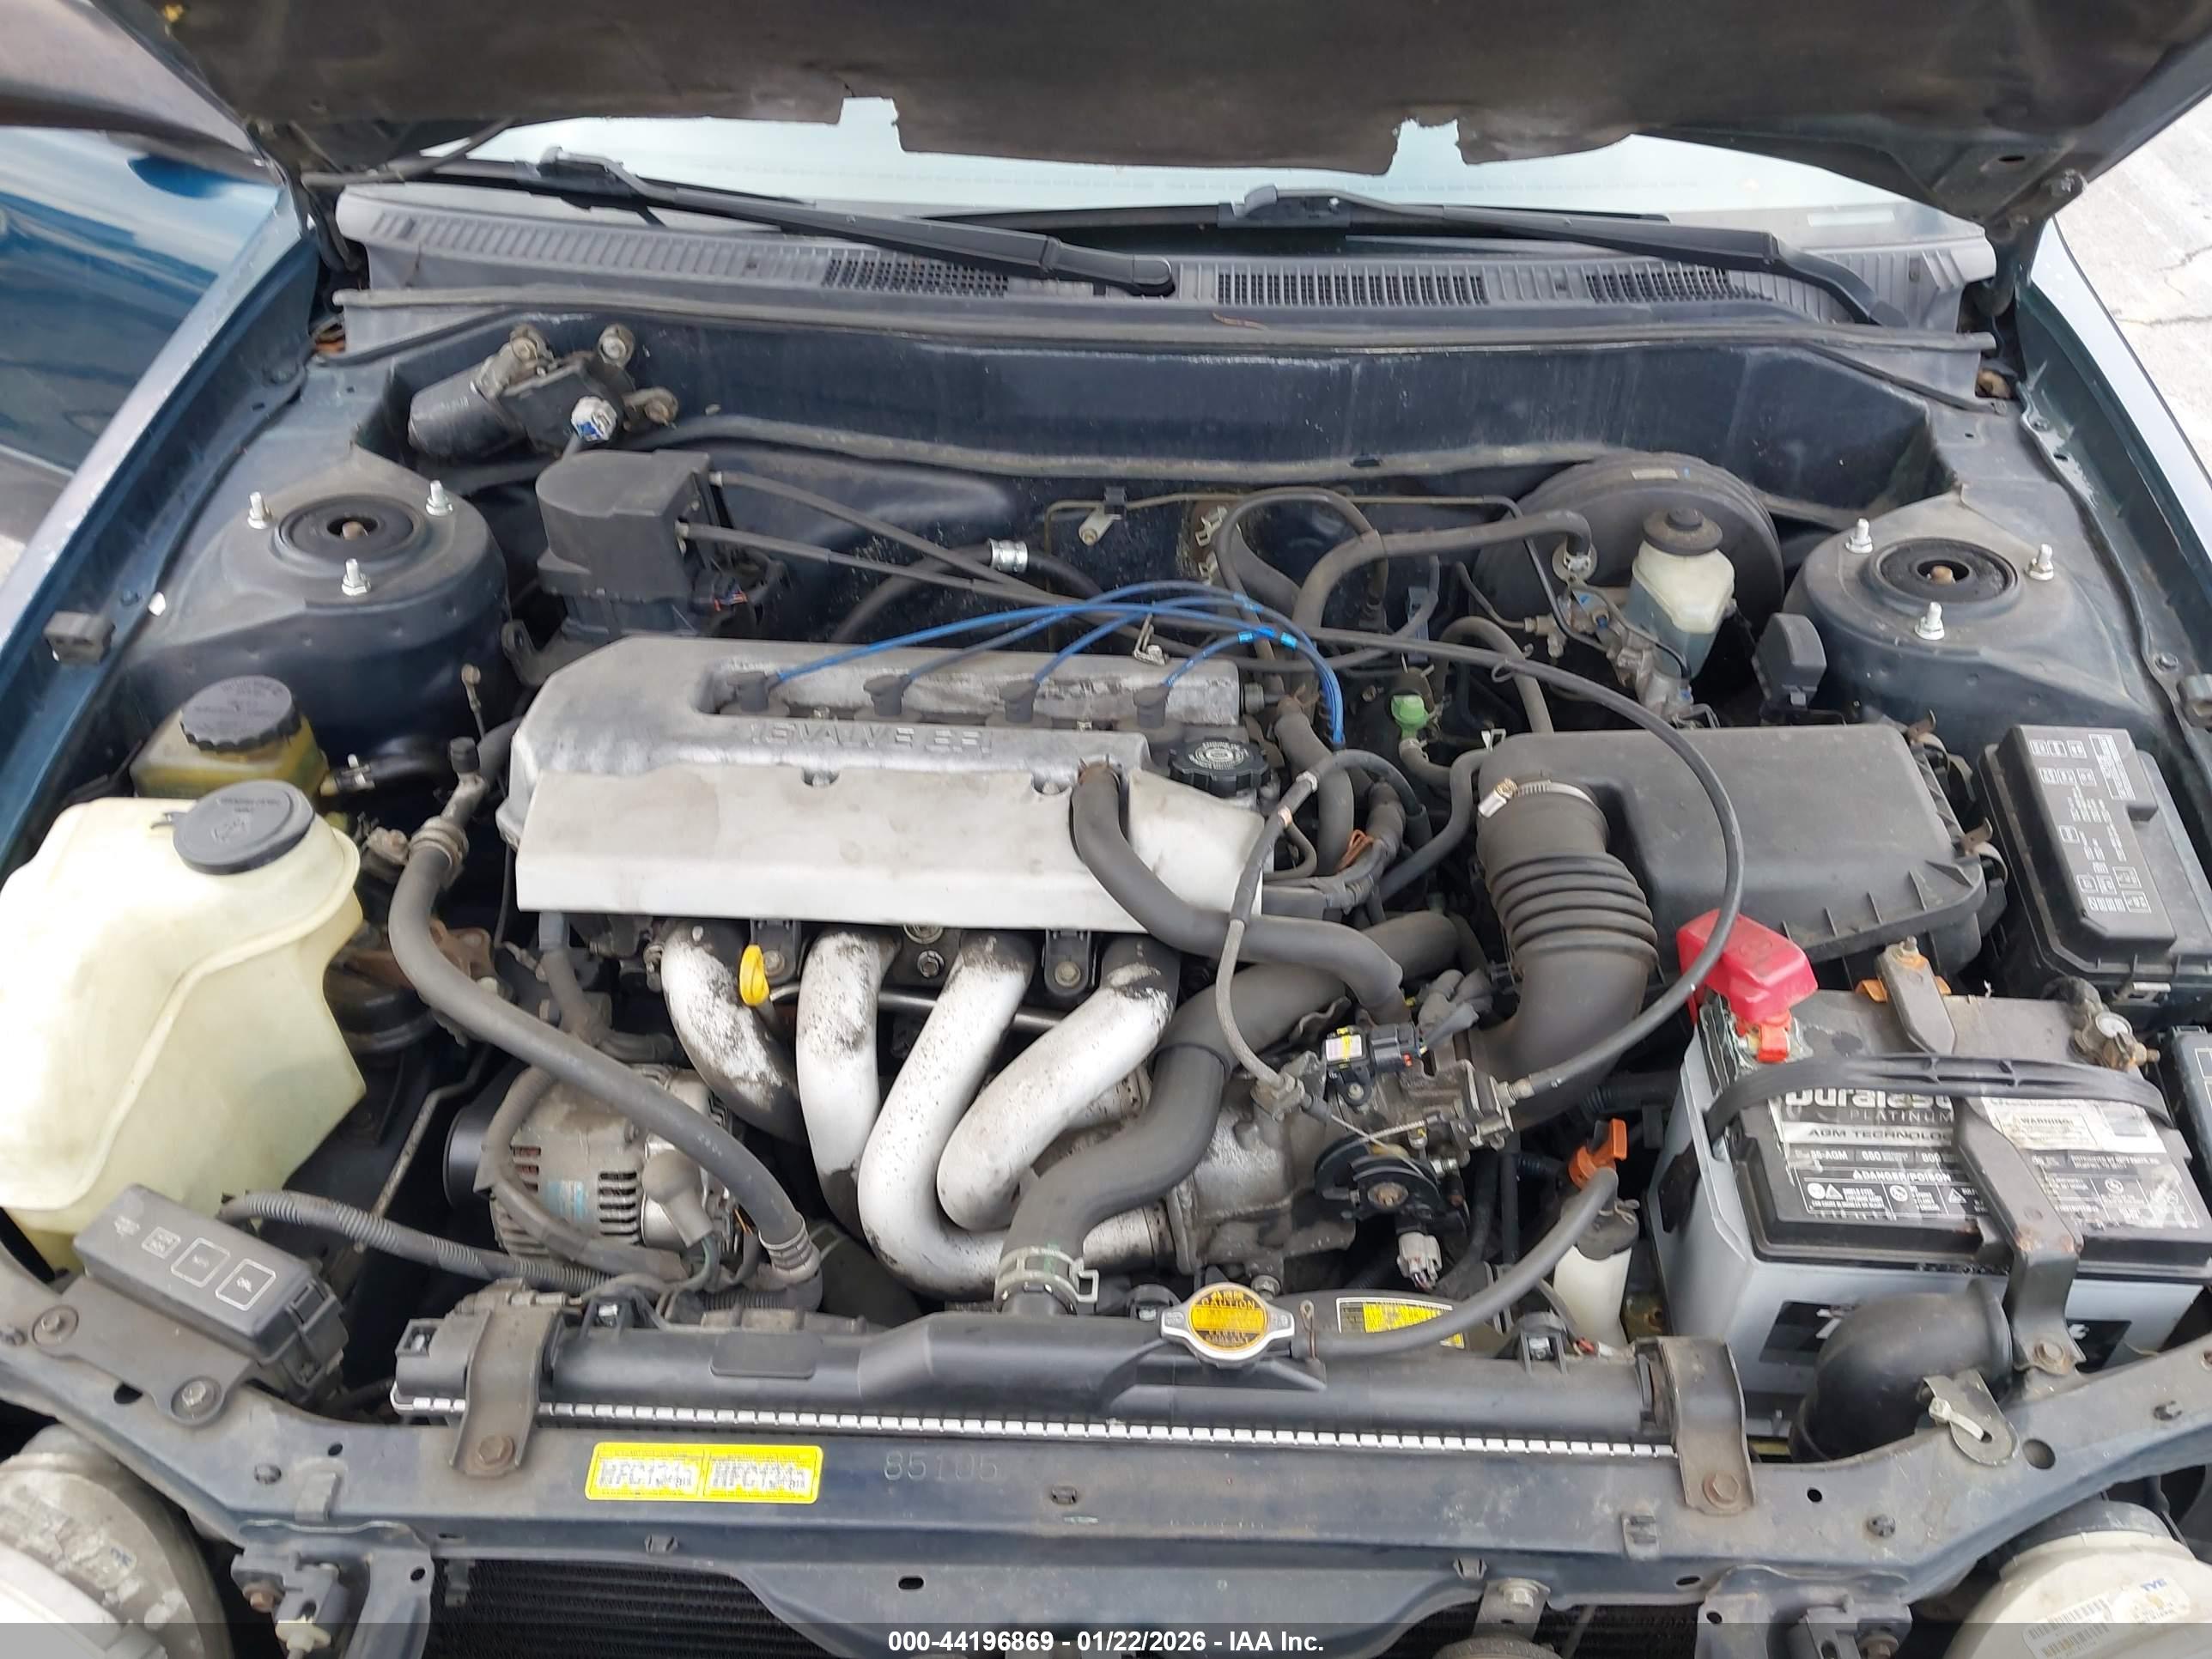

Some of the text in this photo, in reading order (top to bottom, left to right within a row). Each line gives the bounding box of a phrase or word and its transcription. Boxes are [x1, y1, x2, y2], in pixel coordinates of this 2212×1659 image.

[1850, 1109, 1954, 1122] PLATINUM
[1808, 1127, 1847, 1138] AGM
[1201, 1297, 1255, 1310] CAUTION
